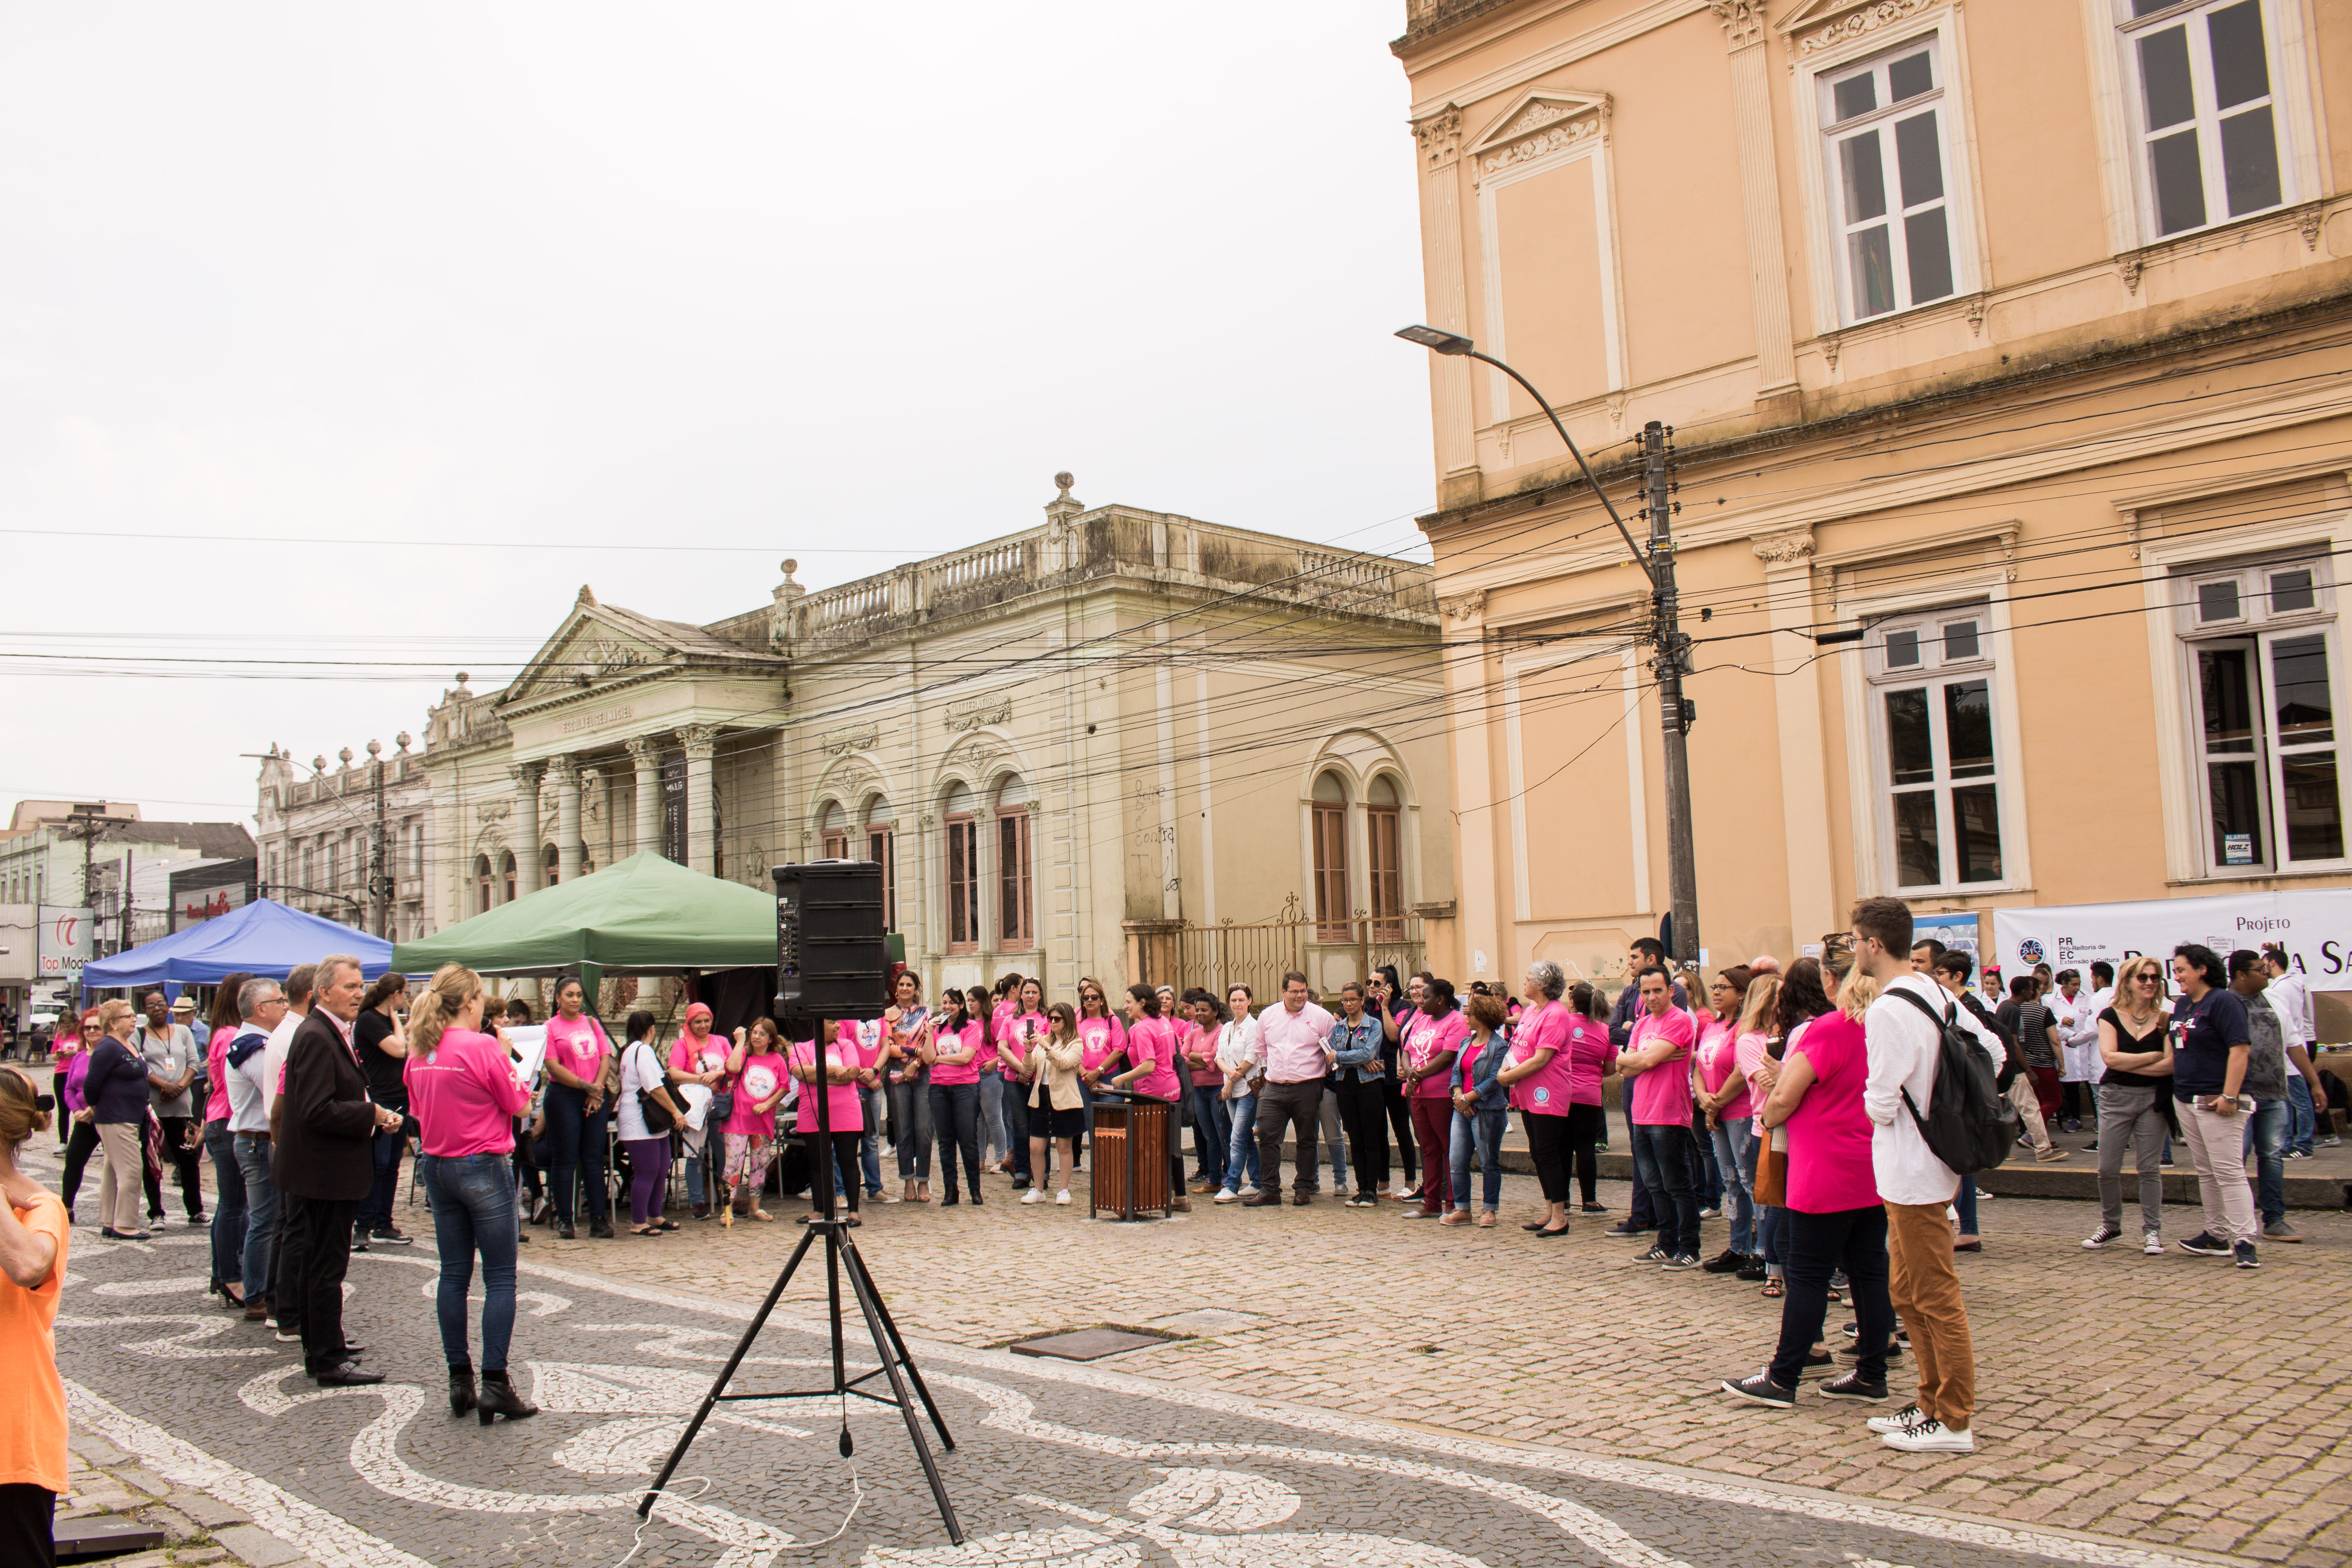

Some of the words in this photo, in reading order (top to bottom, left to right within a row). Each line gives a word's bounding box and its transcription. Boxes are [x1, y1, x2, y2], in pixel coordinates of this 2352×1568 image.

[953, 696, 998, 714] LITTERATURA
[563, 718, 585, 733] ESCOLA
[586, 711, 607, 728] ELISEU
[608, 706, 632, 722] MACIEL
[2058, 937, 2073, 946] PR
[2060, 951, 2074, 959] EC
[42, 956, 59, 972] Top
